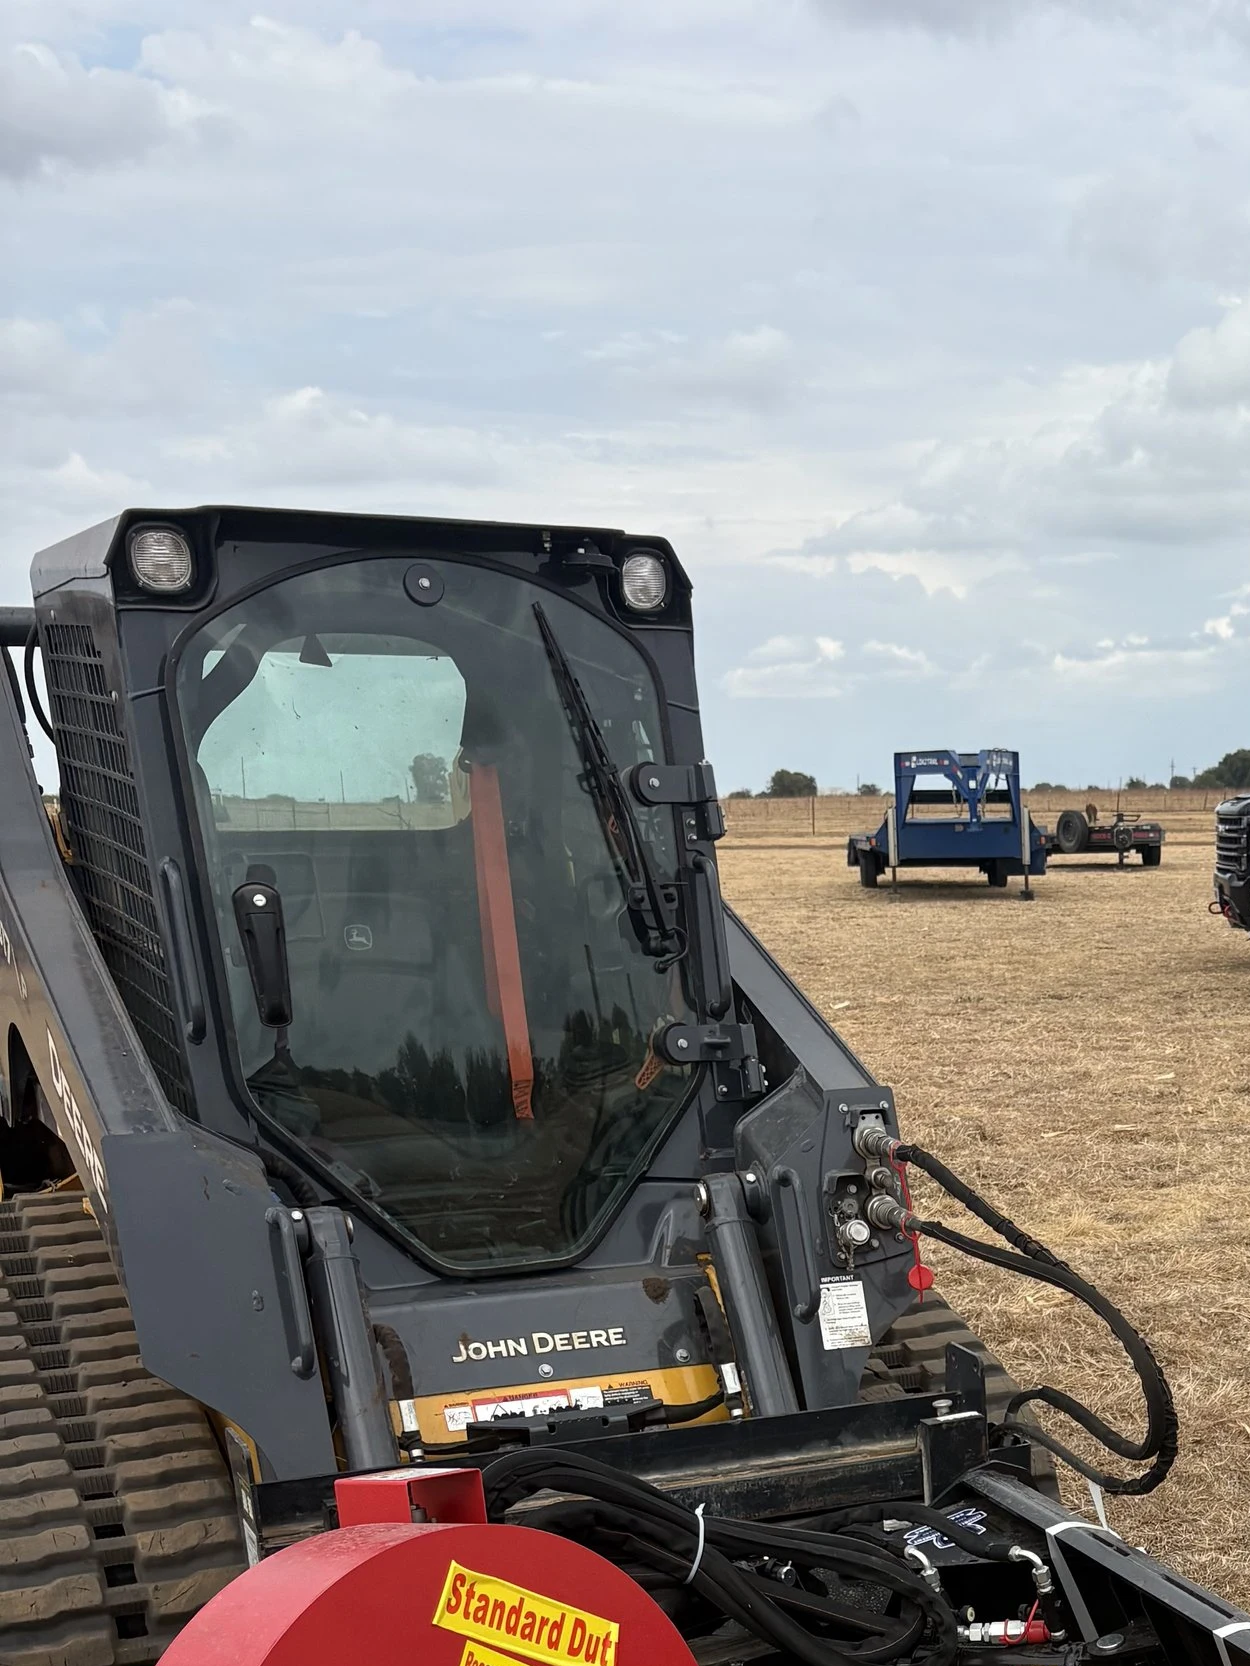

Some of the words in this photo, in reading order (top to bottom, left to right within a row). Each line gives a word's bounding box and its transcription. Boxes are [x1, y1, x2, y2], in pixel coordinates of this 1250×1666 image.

[46, 1020, 108, 1214] DEERE
[820, 1275, 854, 1283] IMPORTANT
[452, 1337, 528, 1363] JOHN
[532, 1327, 625, 1354] DEERE
[446, 1573, 566, 1651] Standard
